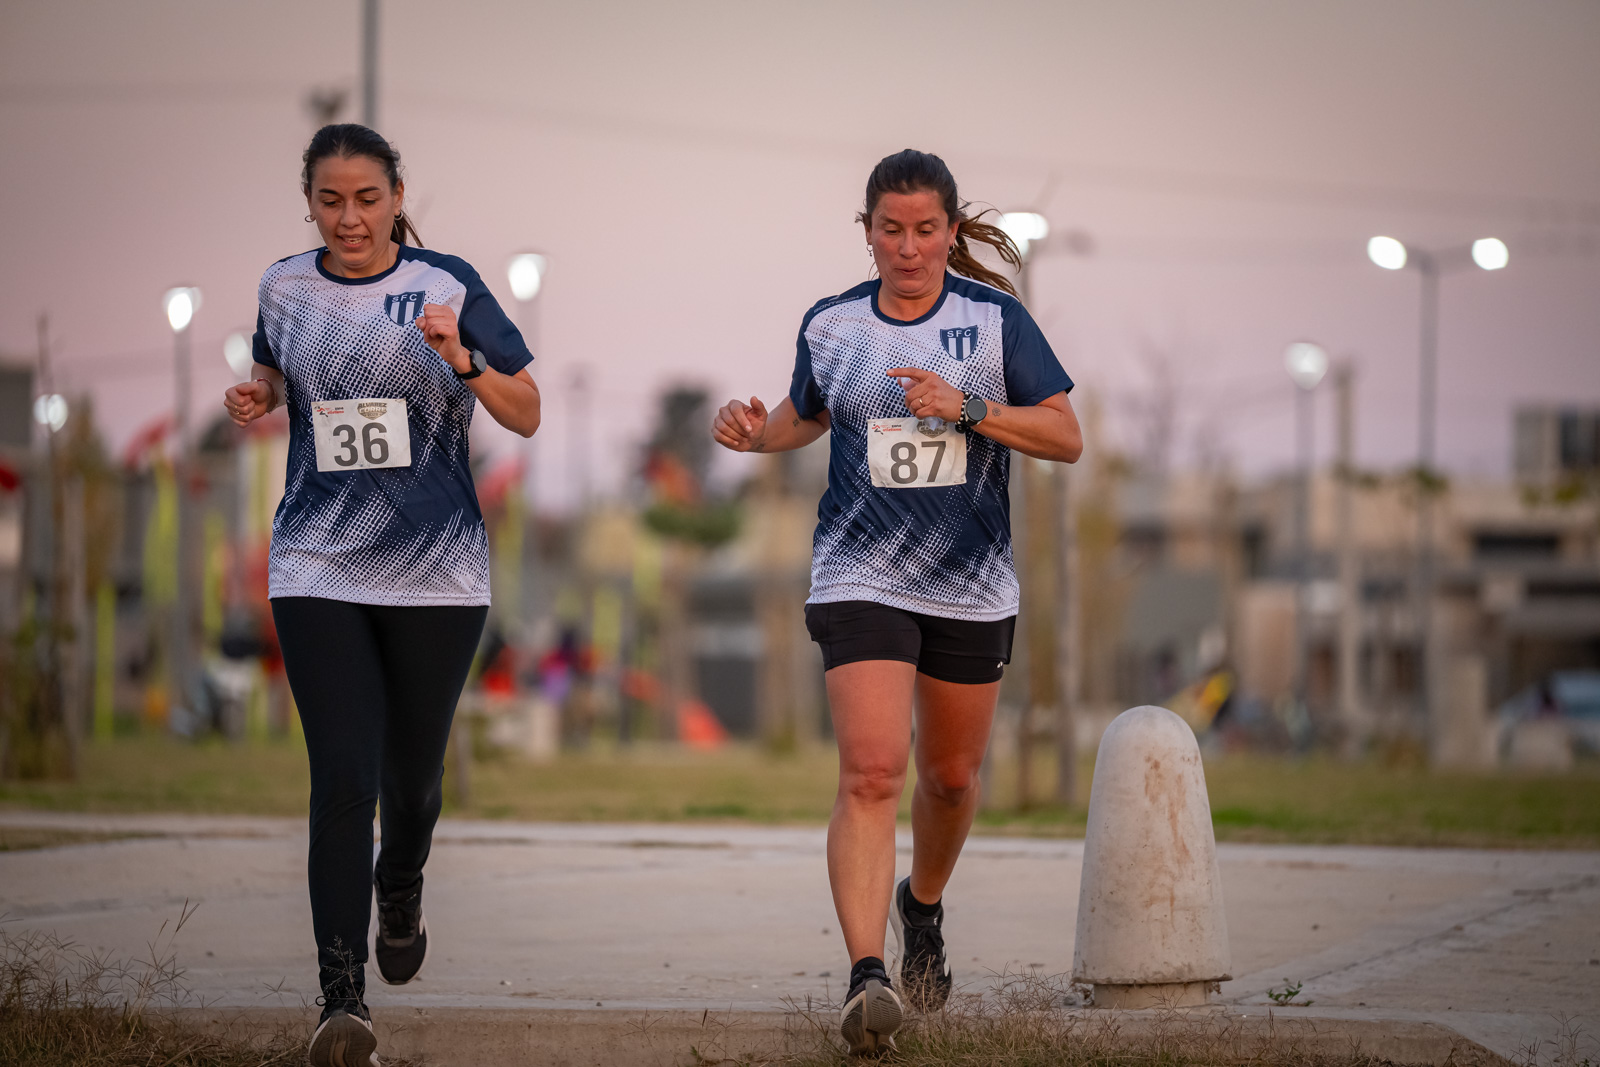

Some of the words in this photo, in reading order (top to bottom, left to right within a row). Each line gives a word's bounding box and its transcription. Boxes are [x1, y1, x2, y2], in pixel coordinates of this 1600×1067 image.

[391, 293, 418, 303] SFC
[946, 329, 972, 338] SFC
[332, 422, 389, 467] 36
[890, 440, 947, 485] 87
